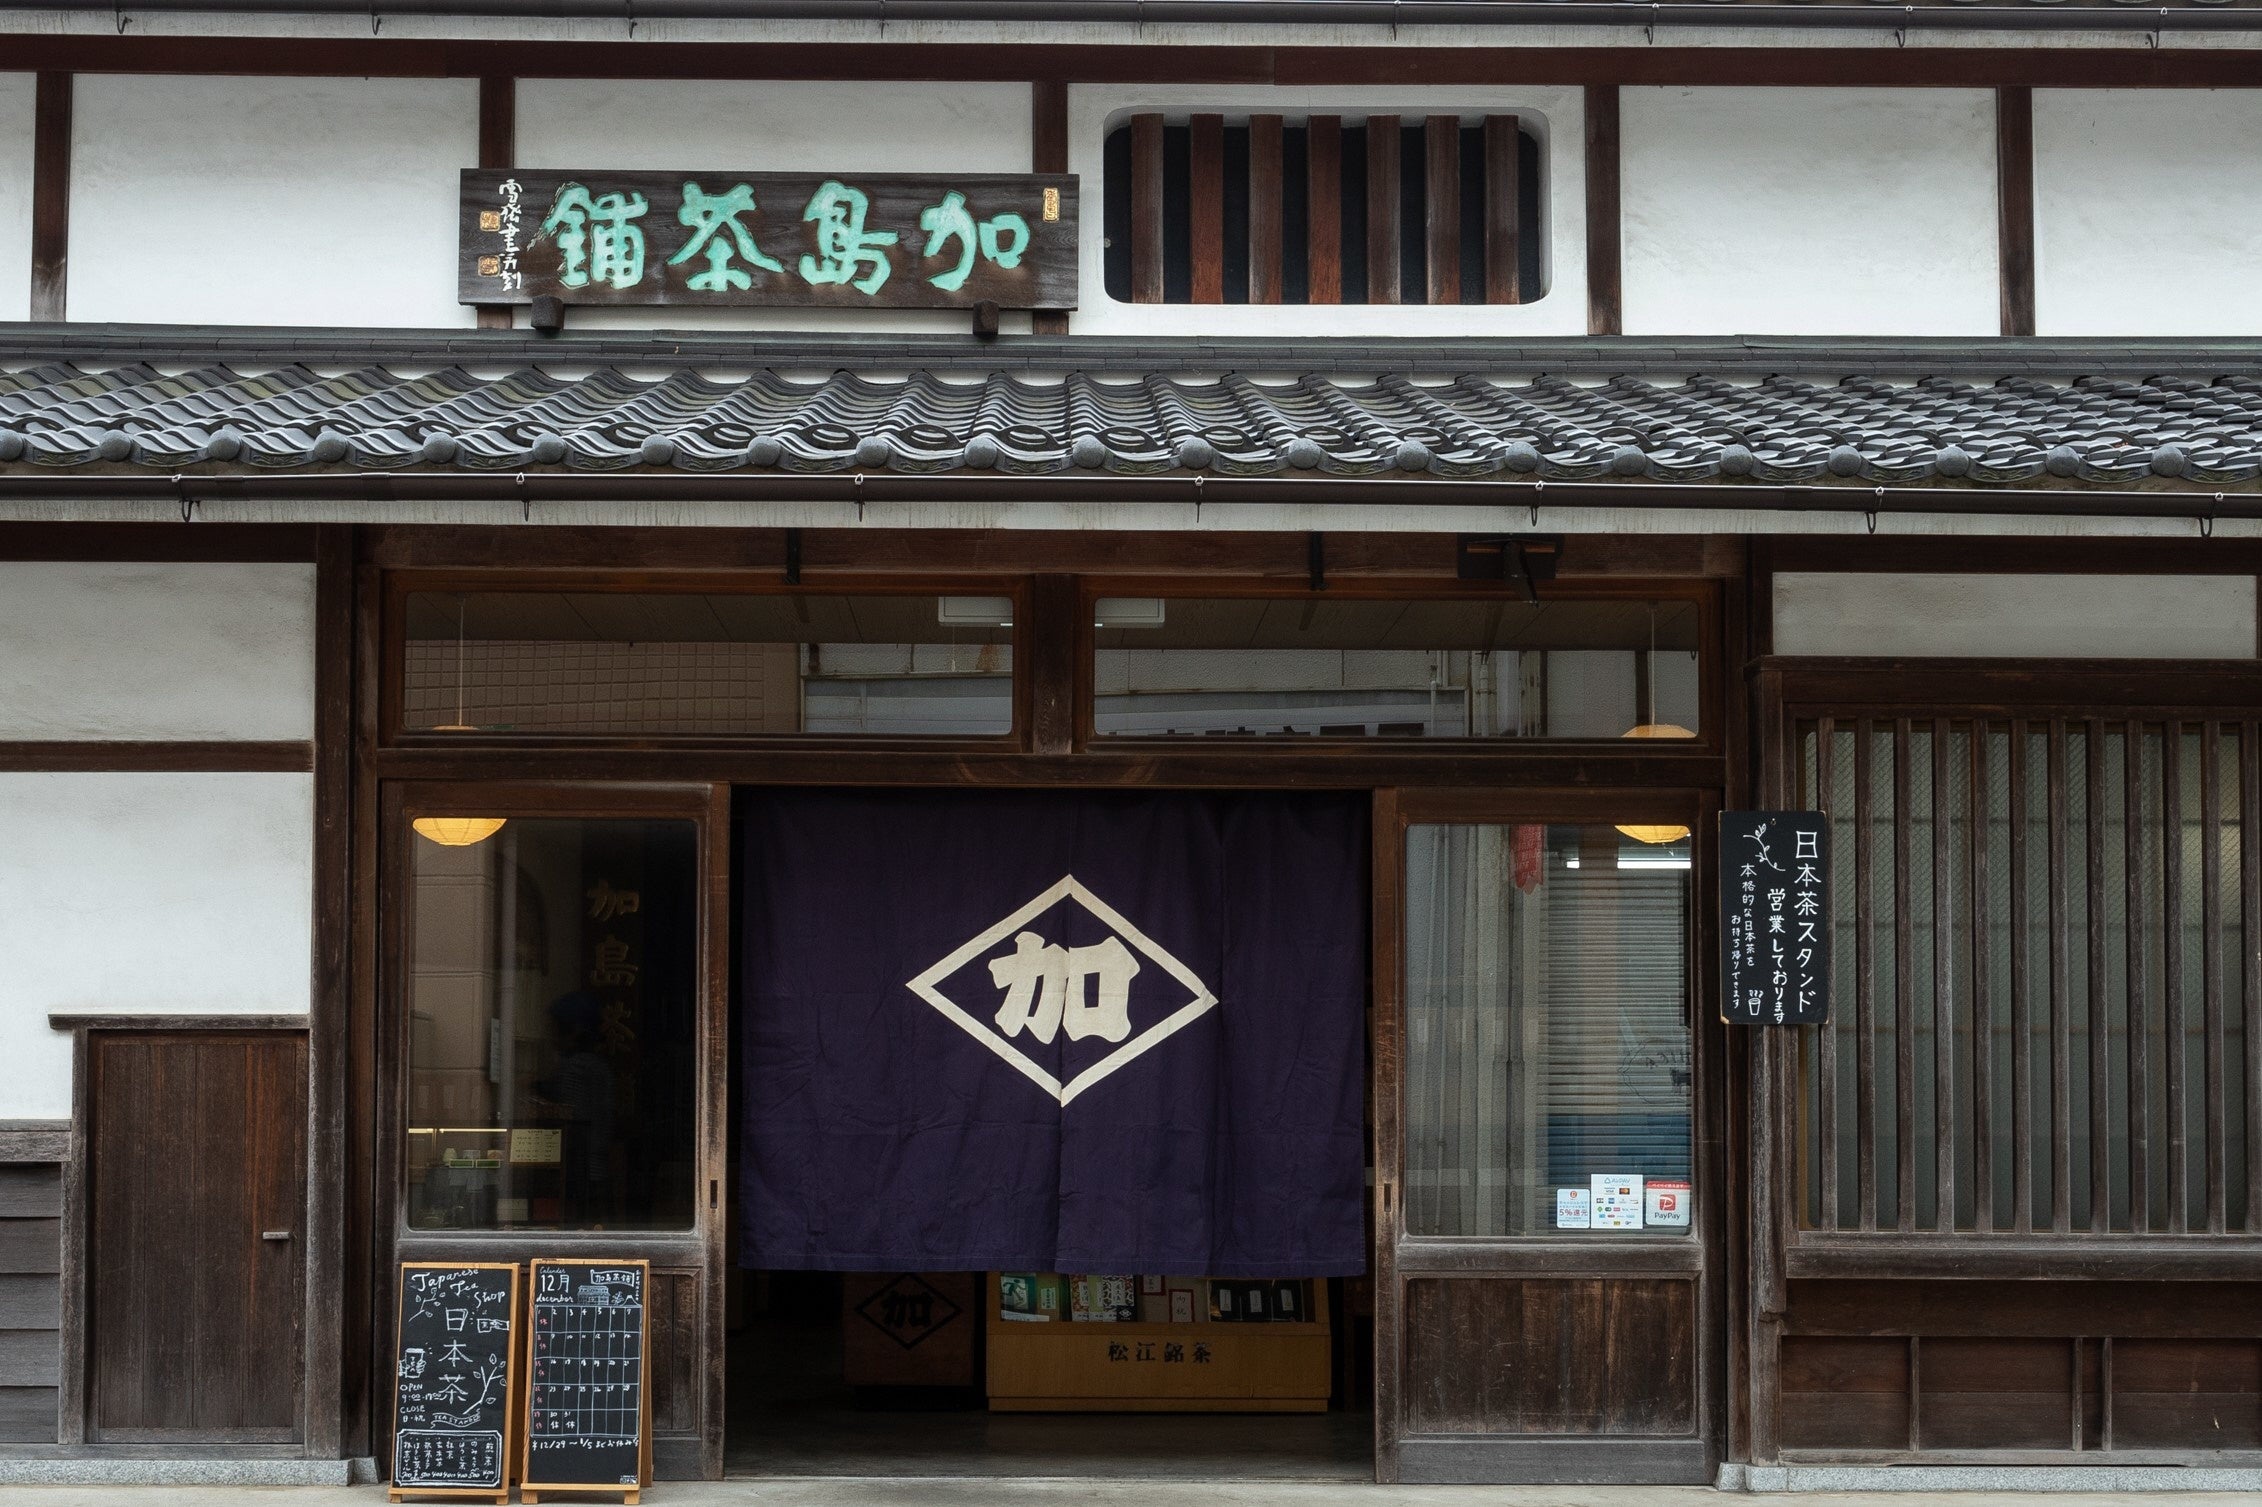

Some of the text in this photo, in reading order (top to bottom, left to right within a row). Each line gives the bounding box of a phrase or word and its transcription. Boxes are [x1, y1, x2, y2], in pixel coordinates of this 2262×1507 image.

[1740, 862, 1758, 967] 本格的な日本茶を
[1794, 830, 1822, 1013] 日本茶スタンド
[1767, 888, 1788, 1025] 営業しております
[987, 930, 1142, 1045] 加
[1654, 1212, 1681, 1220] PayPay
[411, 1269, 479, 1292] Japanese
[450, 1281, 479, 1296] Tea
[541, 1274, 569, 1293] 12月
[474, 1291, 505, 1308] Shop
[880, 1290, 934, 1328] 加
[438, 1307, 474, 1404] 日本茶
[1107, 1340, 1213, 1364] 松江銘茶
[400, 1383, 423, 1392] OPEN
[400, 1405, 425, 1413] CLOSE
